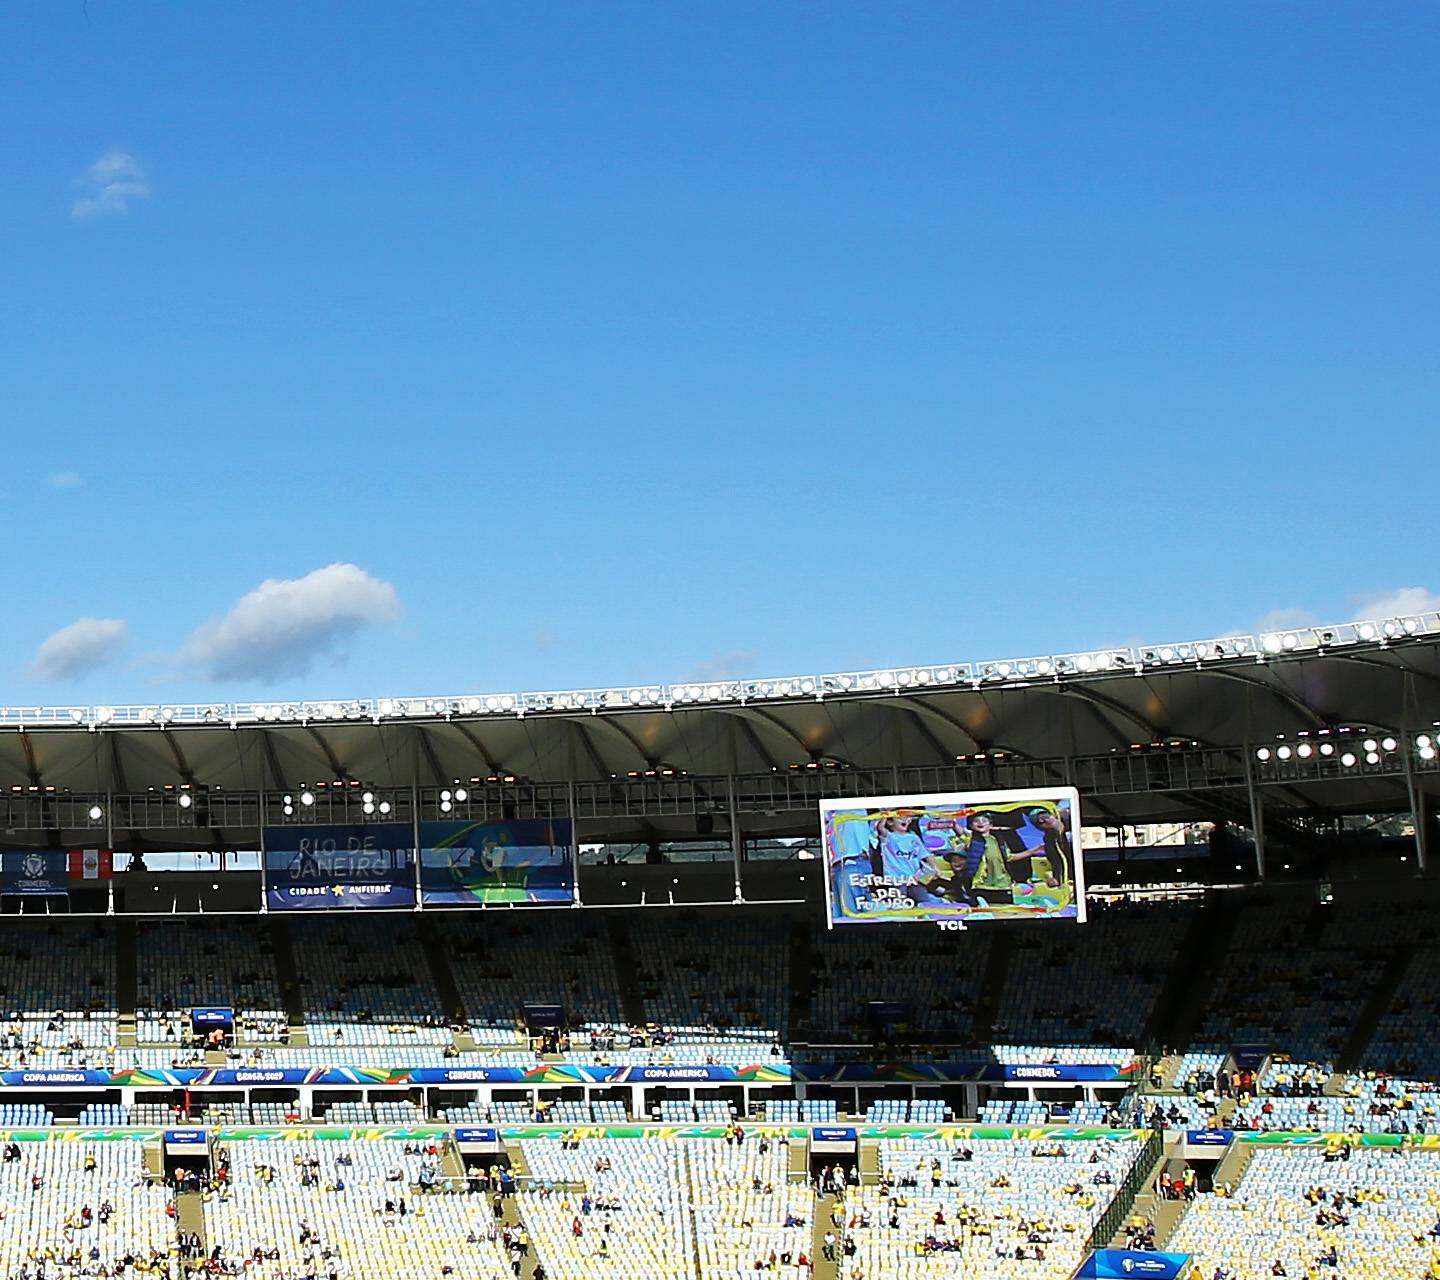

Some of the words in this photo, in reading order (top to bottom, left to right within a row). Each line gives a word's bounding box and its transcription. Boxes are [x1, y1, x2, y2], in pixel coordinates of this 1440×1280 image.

[299, 837, 336, 856] RIO
[348, 836, 376, 855] DE
[289, 887, 326, 896] CIDADE
[875, 888, 906, 899] DEL
[937, 920, 968, 931] TCL
[23, 1073, 45, 1082] COPA
[47, 1073, 85, 1082] AMERICA
[644, 1069, 667, 1078] COPA
[668, 1069, 709, 1079] AMERICA
